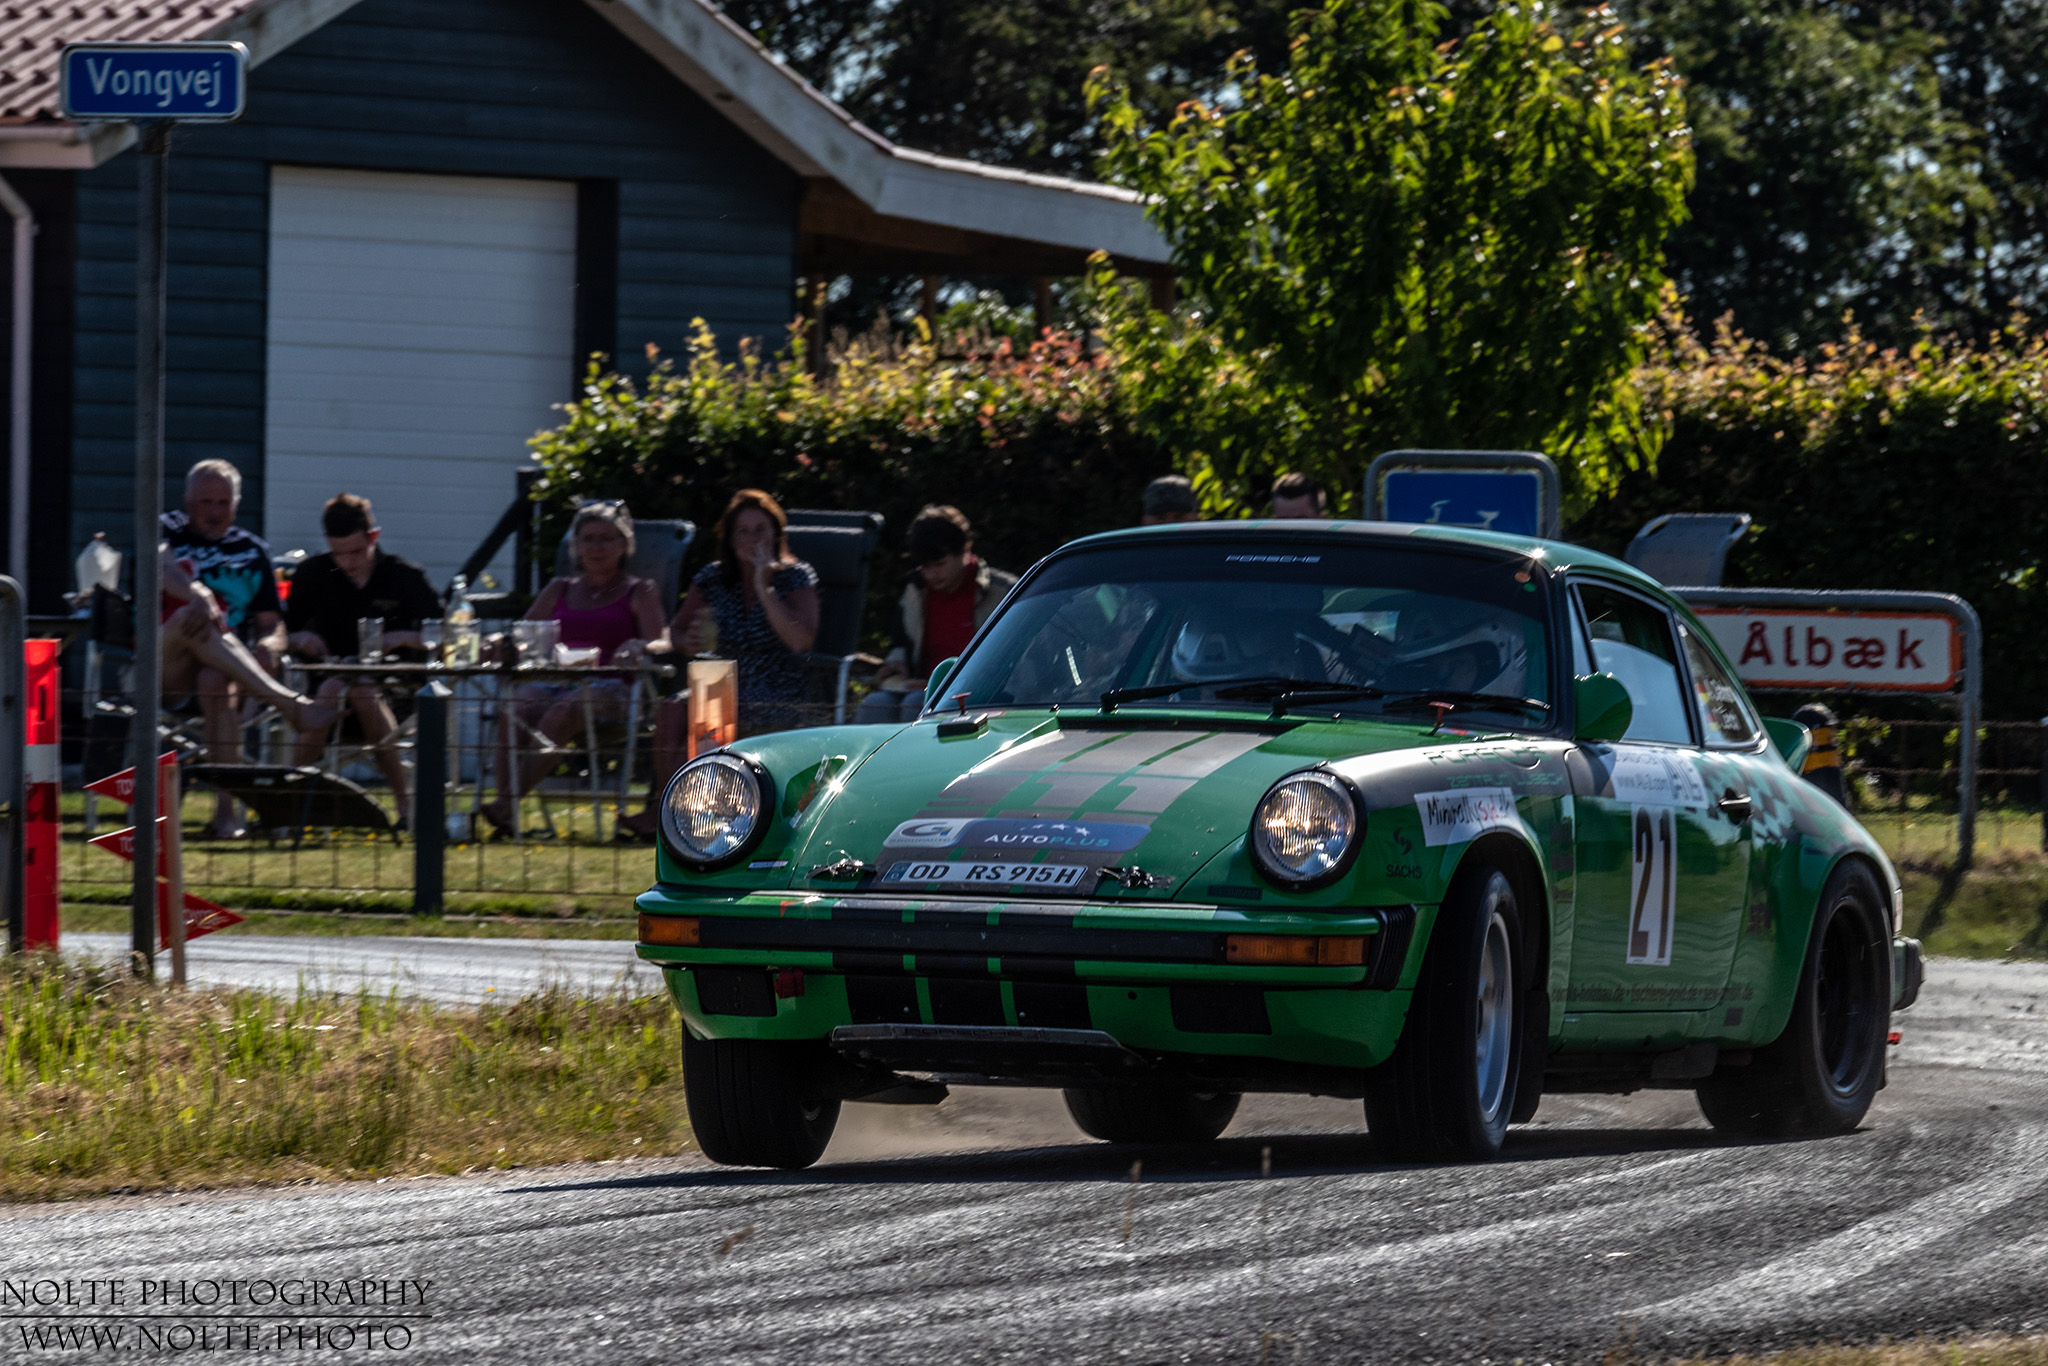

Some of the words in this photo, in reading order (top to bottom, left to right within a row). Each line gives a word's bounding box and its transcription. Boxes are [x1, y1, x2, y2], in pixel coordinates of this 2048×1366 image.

[85, 57, 222, 108] Vongvej
[1225, 555, 1321, 564] PORSCHE
[1740, 620, 1925, 670] Ålbæk
[908, 864, 950, 880] OD
[1386, 863, 1423, 880] SACHS
[1630, 806, 1671, 959] 21
